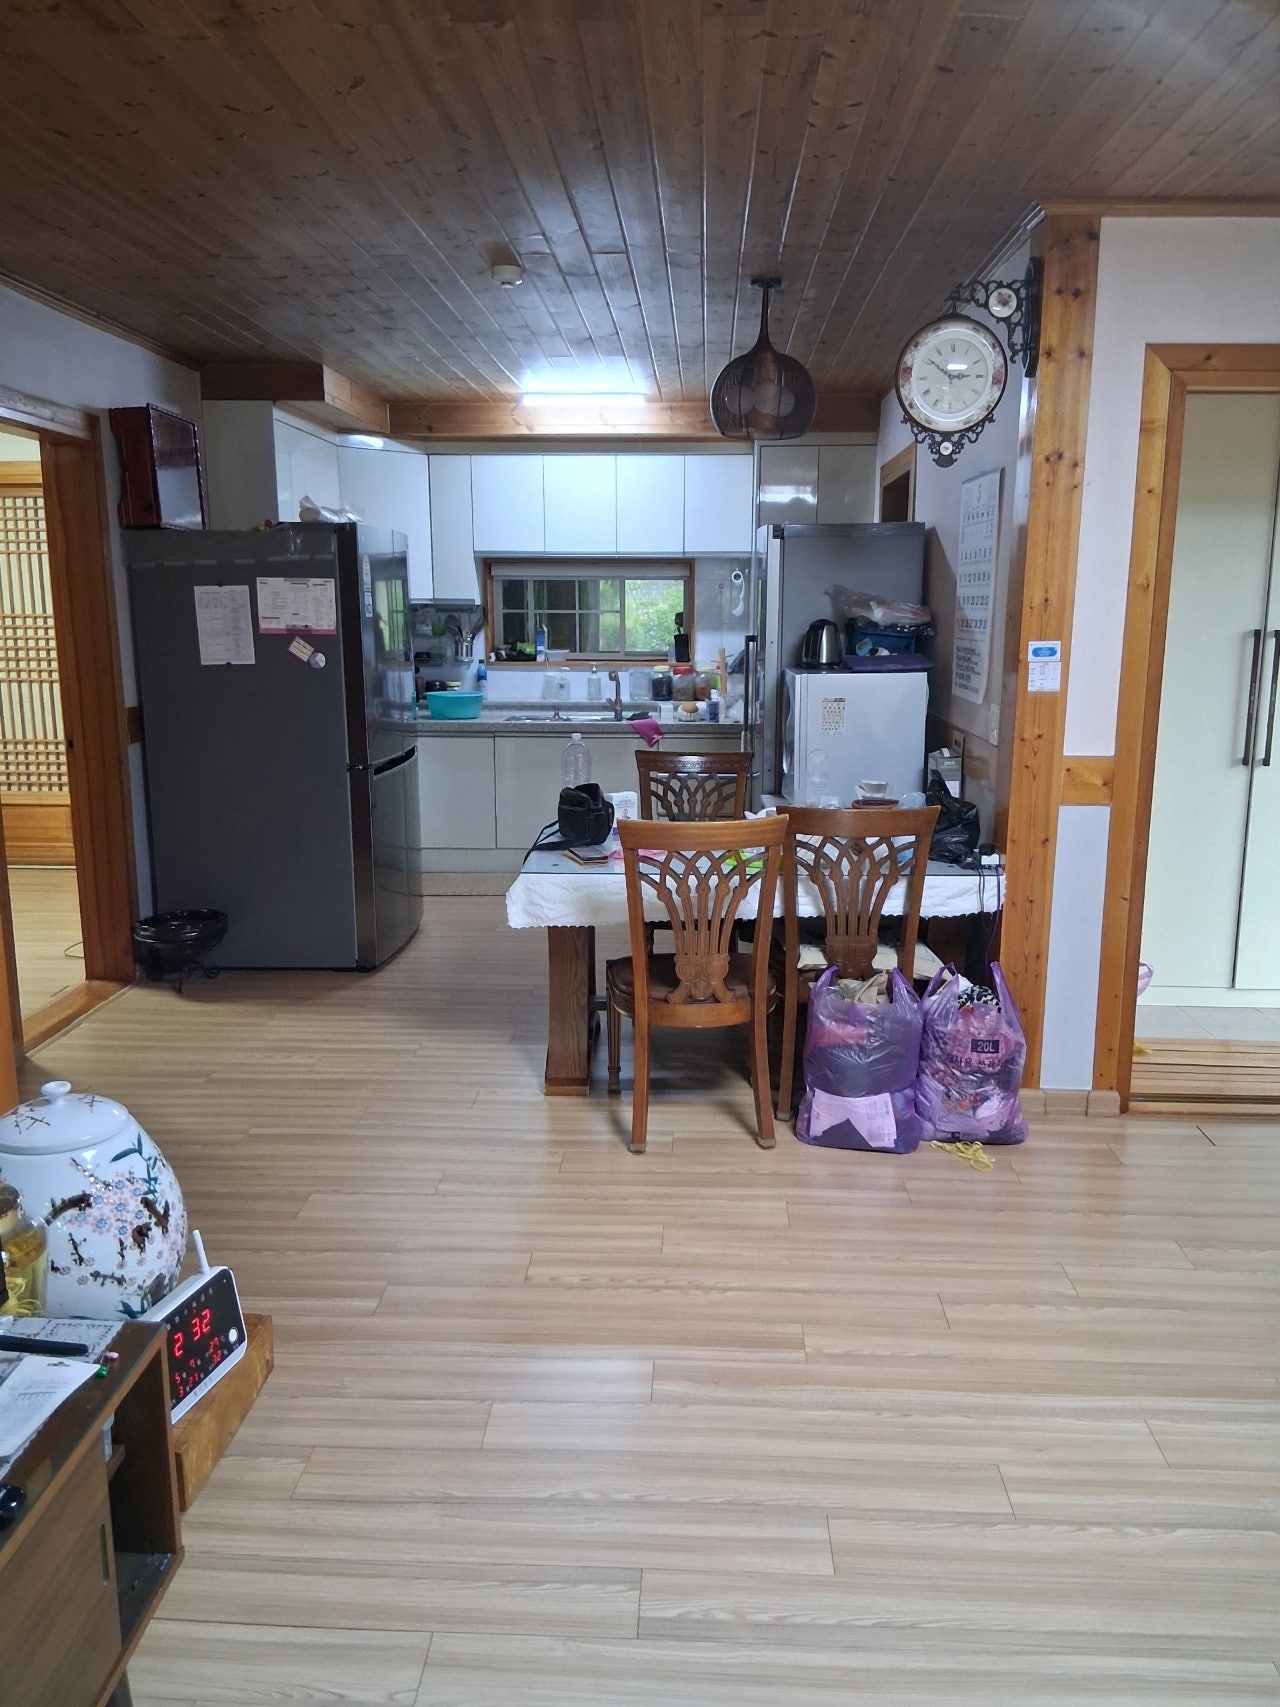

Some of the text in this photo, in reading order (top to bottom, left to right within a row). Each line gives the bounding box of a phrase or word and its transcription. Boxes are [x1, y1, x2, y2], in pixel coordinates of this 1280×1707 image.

[977, 1041, 995, 1052] 20L
[174, 1309, 211, 1357] 2 32
